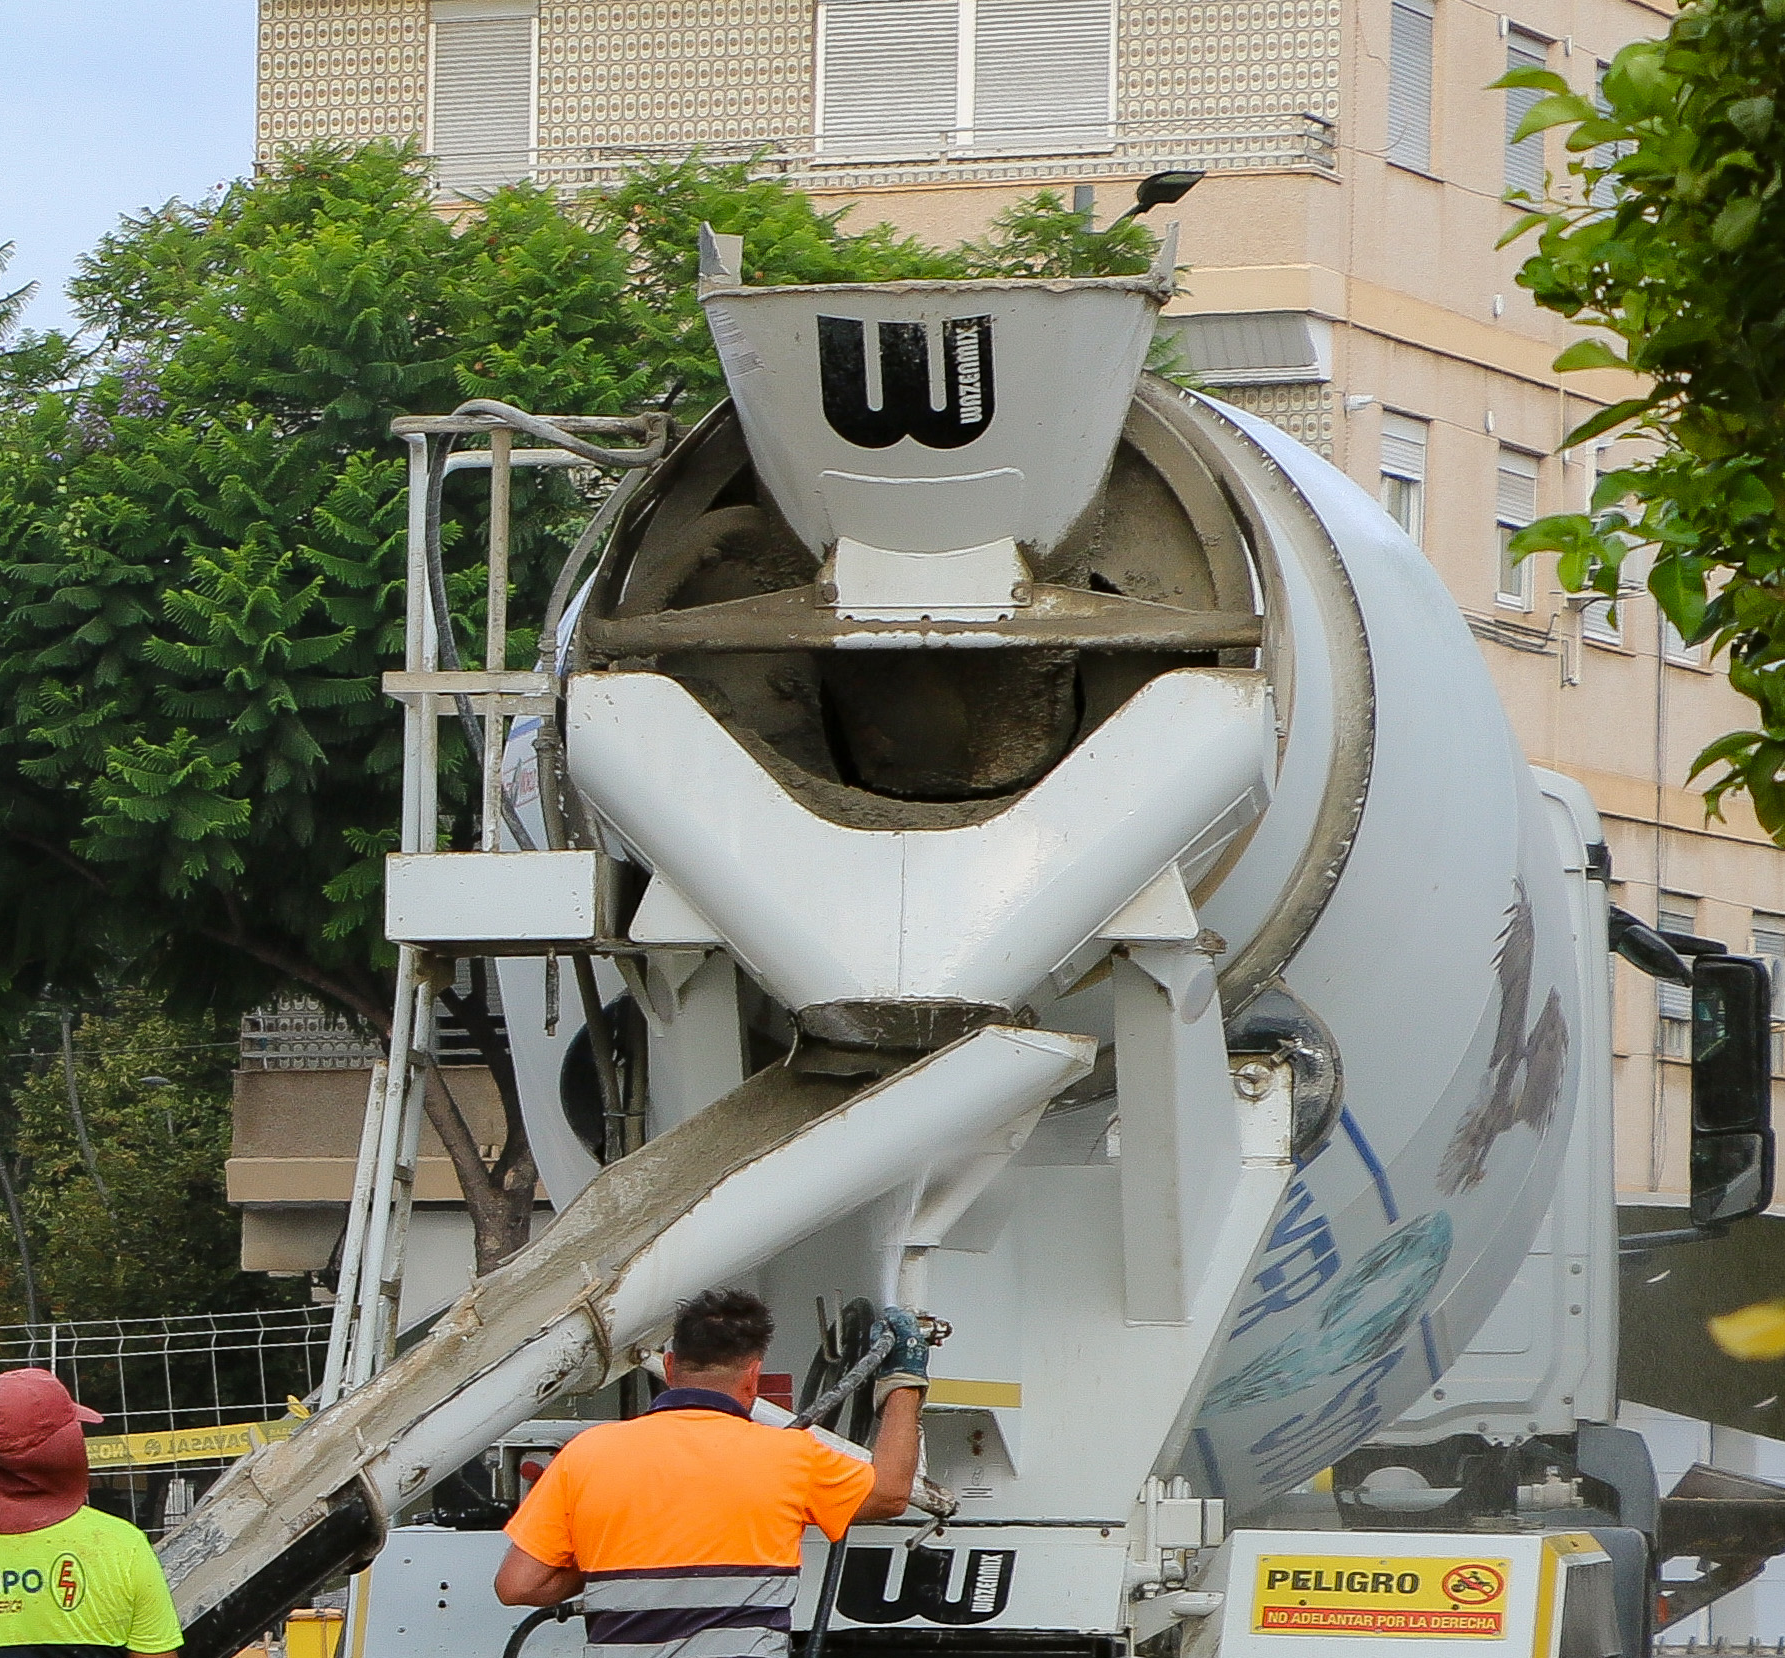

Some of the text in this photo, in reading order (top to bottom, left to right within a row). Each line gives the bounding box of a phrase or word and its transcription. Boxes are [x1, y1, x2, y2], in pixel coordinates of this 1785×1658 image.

[971, 1553, 1003, 1613] WAZENMIX
[1267, 1569, 1420, 1594] PELIGRO
[1267, 1612, 1497, 1630] NO ADELANTAR POR LA DERECHA
